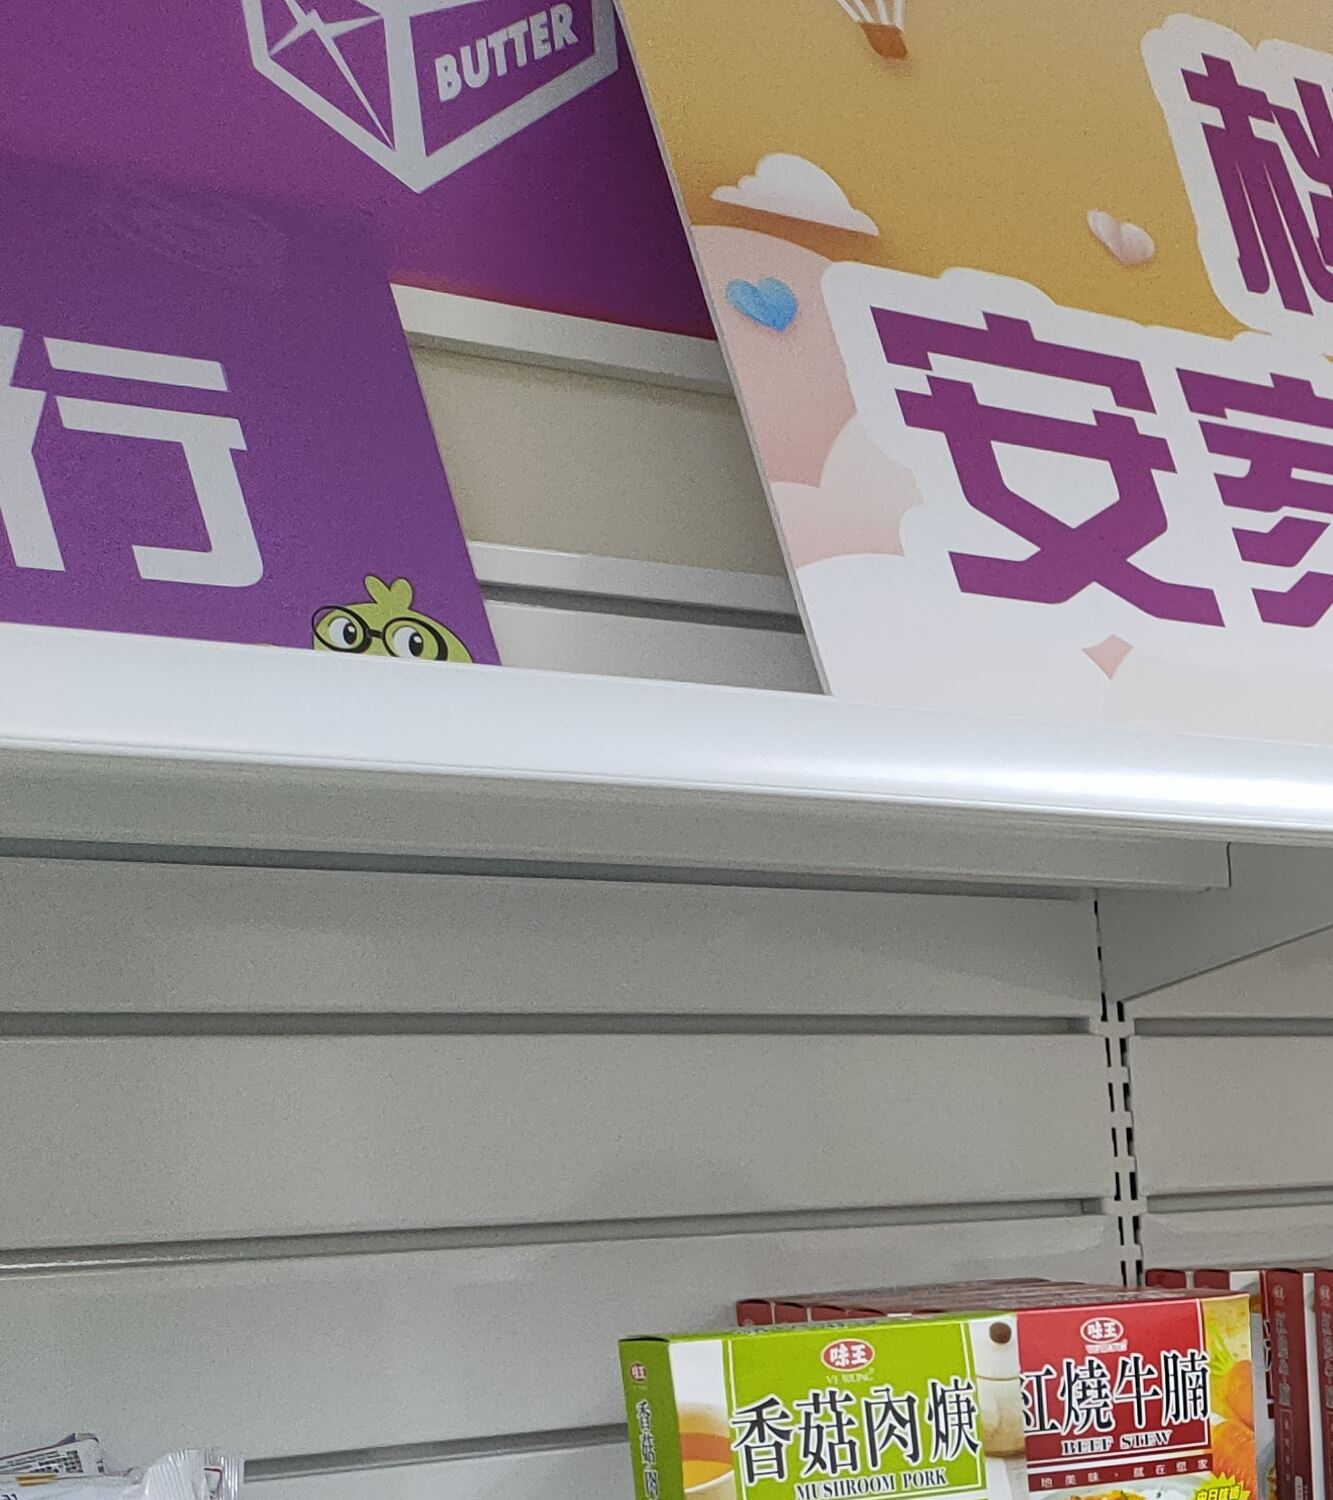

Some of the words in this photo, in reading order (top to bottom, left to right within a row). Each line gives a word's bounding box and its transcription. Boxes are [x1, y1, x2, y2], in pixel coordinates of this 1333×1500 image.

[435, 4, 578, 103] BUTTER
[1087, 1320, 1119, 1341] 味王
[828, 1344, 870, 1367] 味王
[1020, 1351, 1210, 1436] 紅燒牛腩
[1062, 1436, 1113, 1456] BEEF
[1120, 1430, 1173, 1450] STEW
[901, 1469, 947, 1491] PORK
